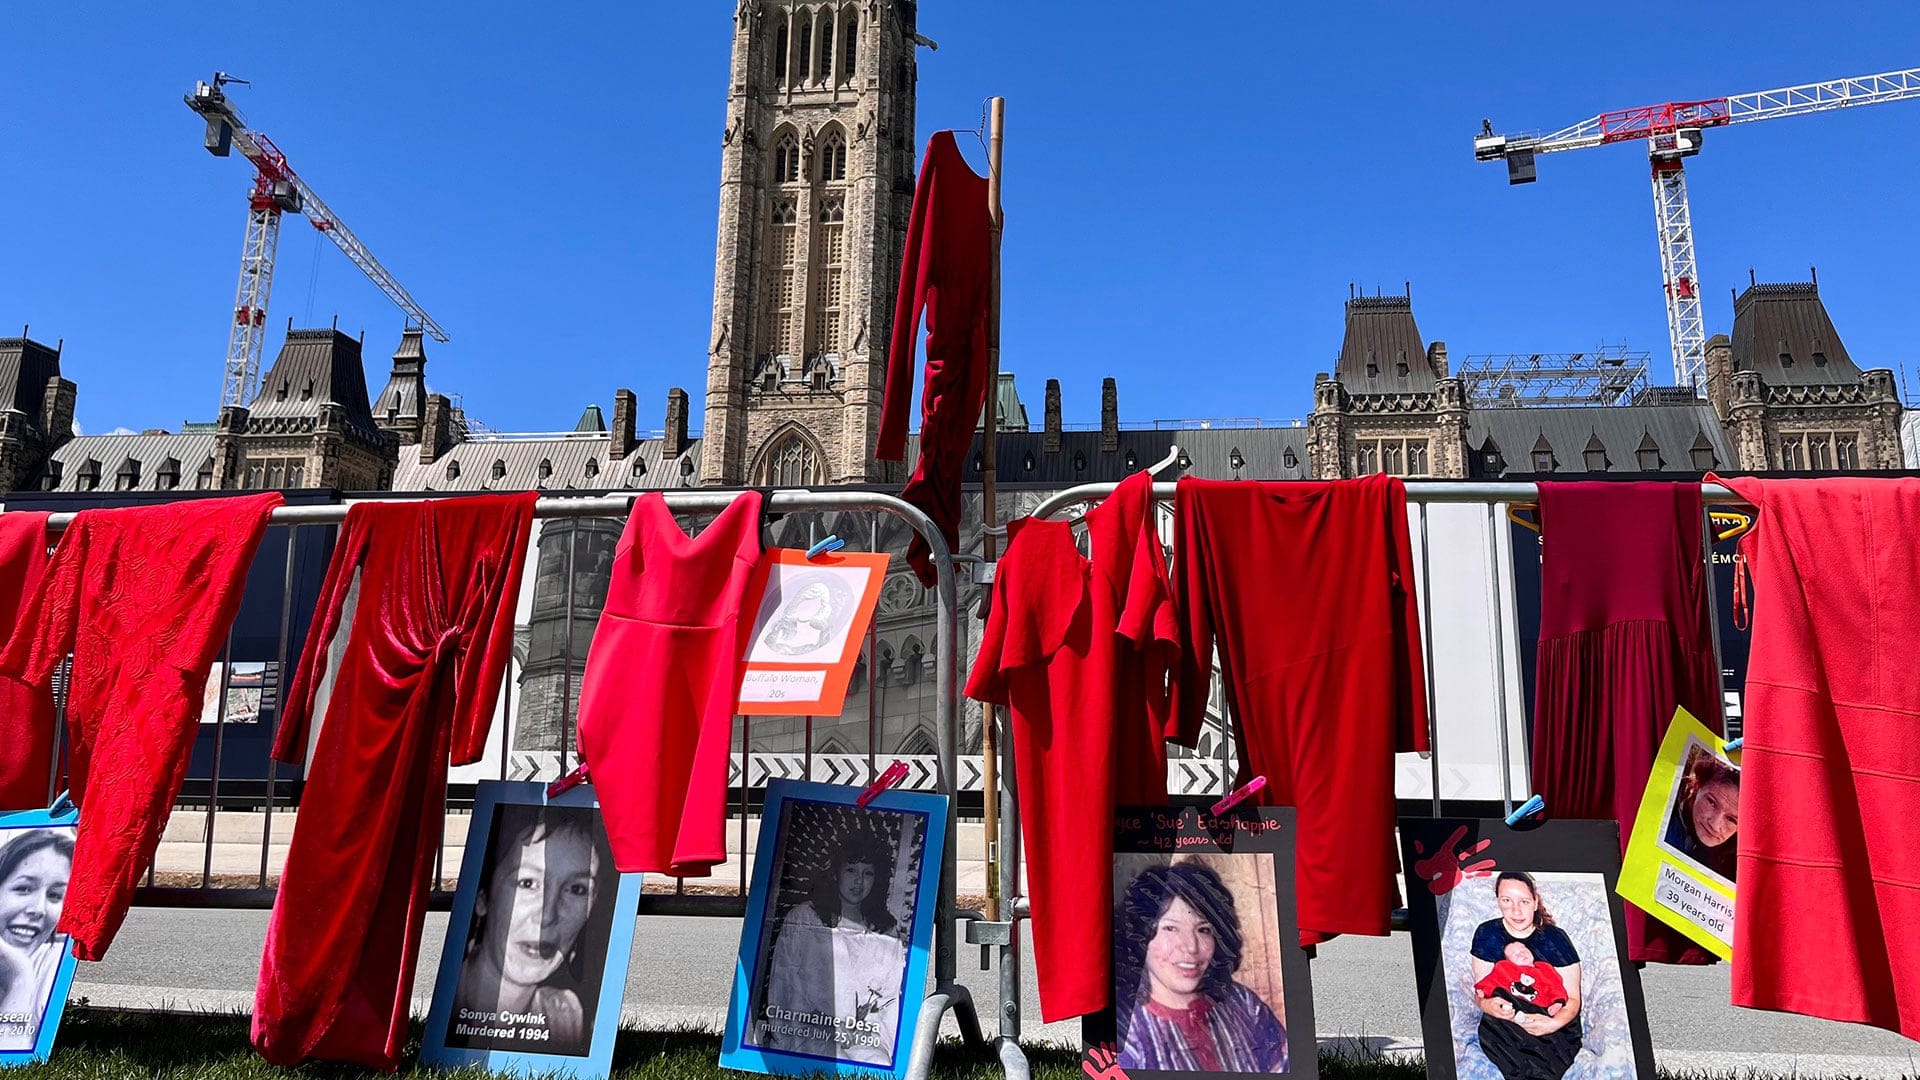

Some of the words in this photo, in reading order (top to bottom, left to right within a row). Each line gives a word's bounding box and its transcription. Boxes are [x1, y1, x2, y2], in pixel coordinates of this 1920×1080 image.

[746, 673, 778, 683] Buffalo
[781, 674, 819, 684] Woman,
[769, 689, 786, 699] 20s
[1153, 836, 1172, 849] 42
[1175, 834, 1209, 849] years
[1665, 868, 1701, 898] Morgan
[1703, 892, 1735, 920] Harris,
[1666, 889, 1680, 904] 39
[1681, 901, 1705, 921] years
[1708, 918, 1724, 932] old
[459, 1008, 497, 1023] Sonya
[500, 1011, 546, 1025] Cywink
[766, 1005, 840, 1027] Charmaine
[845, 1015, 881, 1033] Desa
[11, 1025, 35, 1035] 2010
[456, 1024, 516, 1038] Murdered
[518, 1027, 550, 1041] 1994
[760, 1023, 810, 1037] murdered
[811, 1029, 832, 1042] July
[833, 1031, 850, 1046] 25,
[854, 1034, 881, 1048] 1990
